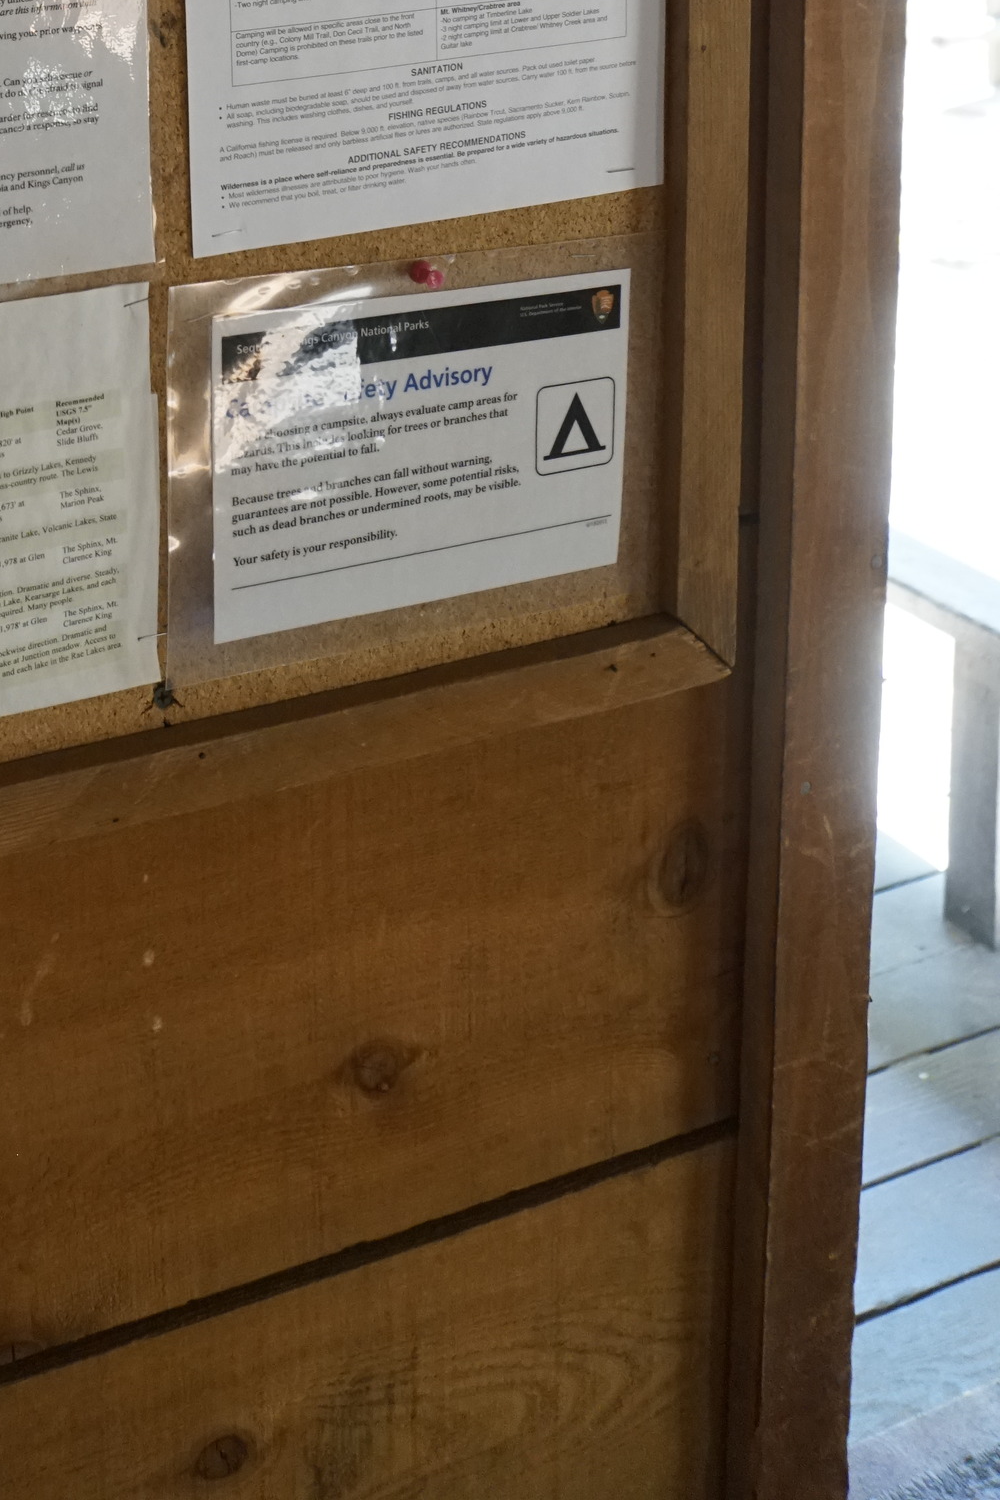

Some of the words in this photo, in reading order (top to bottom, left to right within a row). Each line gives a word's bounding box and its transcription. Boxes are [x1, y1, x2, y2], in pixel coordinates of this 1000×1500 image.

[411, 62, 464, 77] SANITATION
[388, 108, 423, 121] FISHING
[425, 99, 487, 116] REGULATIONS
[347, 148, 400, 164] ADDITIONAL
[403, 143, 436, 157] SAFETY
[439, 130, 526, 151] RECOMMENDATIONS
[360, 322, 402, 338] National
[403, 319, 430, 332] Parks
[403, 363, 493, 393] Advisory
[312, 425, 319, 433] a
[319, 417, 368, 432] campsite,
[370, 411, 403, 424] always
[405, 404, 445, 418] evaluate
[447, 400, 474, 412] camp
[475, 395, 501, 407] areas
[503, 392, 518, 403] for
[347, 429, 385, 442] looking
[387, 426, 402, 436] for
[403, 422, 428, 434] trees
[429, 420, 441, 429] or
[443, 412, 487, 427] branches
[488, 408, 509, 420] that
[231, 465, 252, 476] may
[254, 461, 279, 472] have
[280, 456, 298, 468] the
[298, 448, 346, 468] potential
[347, 448, 358, 457] to
[360, 443, 380, 455] fall.
[231, 504, 288, 524] guarantees
[290, 501, 308, 512] are
[307, 497, 327, 509] not
[328, 490, 369, 508] possible.
[374, 483, 420, 498] However,
[422, 478, 447, 490] some
[449, 468, 492, 487] potential
[494, 465, 519, 478] risks,
[232, 493, 273, 507] Because
[276, 488, 303, 500] trees
[323, 476, 371, 492] branches
[373, 474, 391, 484] can
[392, 468, 409, 481] fall
[411, 463, 448, 478] without
[450, 458, 492, 472] warning,
[232, 524, 256, 538] such
[258, 524, 269, 533] as
[271, 517, 296, 531] dead
[299, 510, 345, 526] branches
[347, 508, 359, 518] or
[360, 494, 421, 515] undermined
[423, 492, 451, 504] roots,
[453, 488, 472, 499] may
[474, 484, 486, 495] be
[488, 478, 521, 492] visible.
[233, 555, 257, 567] Your
[259, 549, 289, 562] safety
[292, 546, 300, 556] is
[302, 543, 326, 557] your
[328, 530, 398, 550] responsibility.
